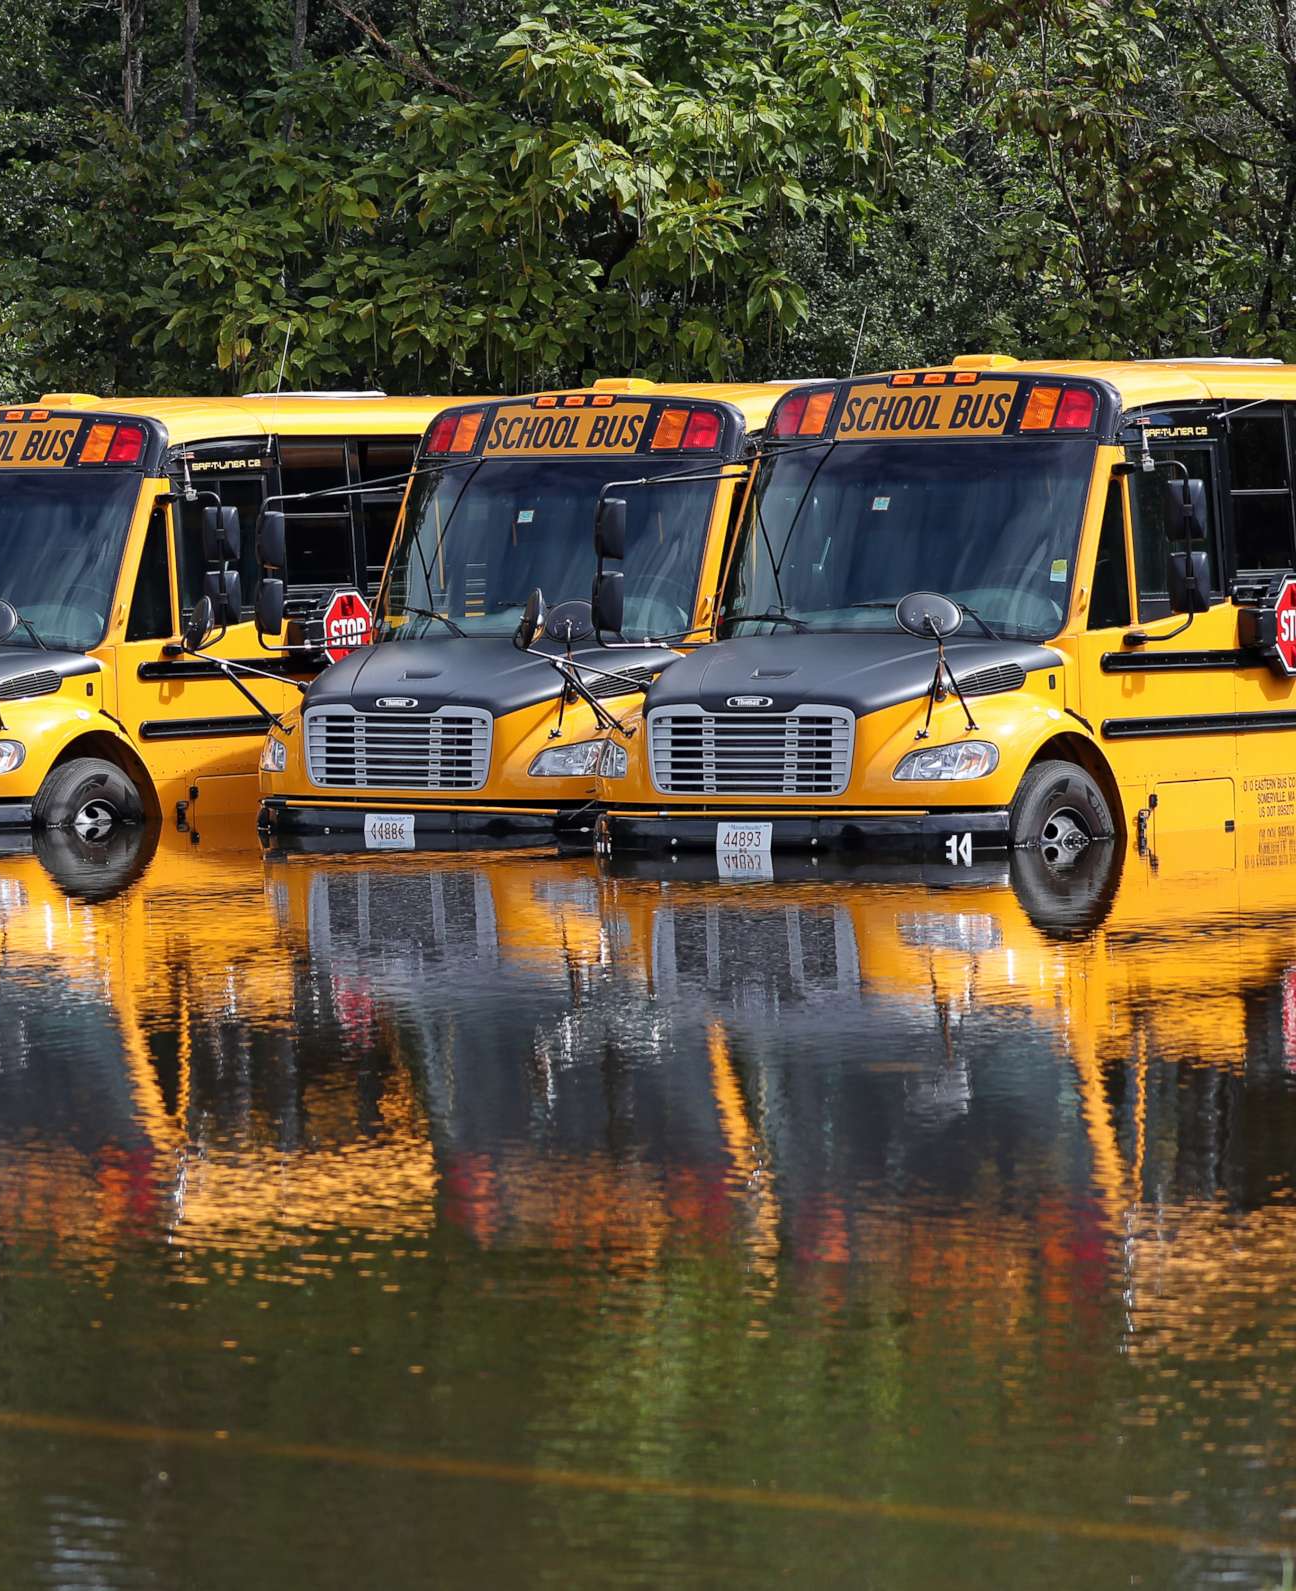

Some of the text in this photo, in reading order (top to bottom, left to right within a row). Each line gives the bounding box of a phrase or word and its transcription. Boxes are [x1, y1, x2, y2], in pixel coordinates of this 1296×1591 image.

[840, 393, 1011, 432] SCHOOL BUS
[487, 415, 644, 449] SCHOOL BUS
[1195, 426, 1208, 436] C2
[20, 429, 75, 461] BUS
[247, 458, 261, 467] C2
[331, 617, 366, 646] STOP
[1281, 610, 1296, 642] ST
[1277, 777, 1287, 789] BUS
[1267, 805, 1276, 817] DOT
[724, 831, 762, 847] 44893
